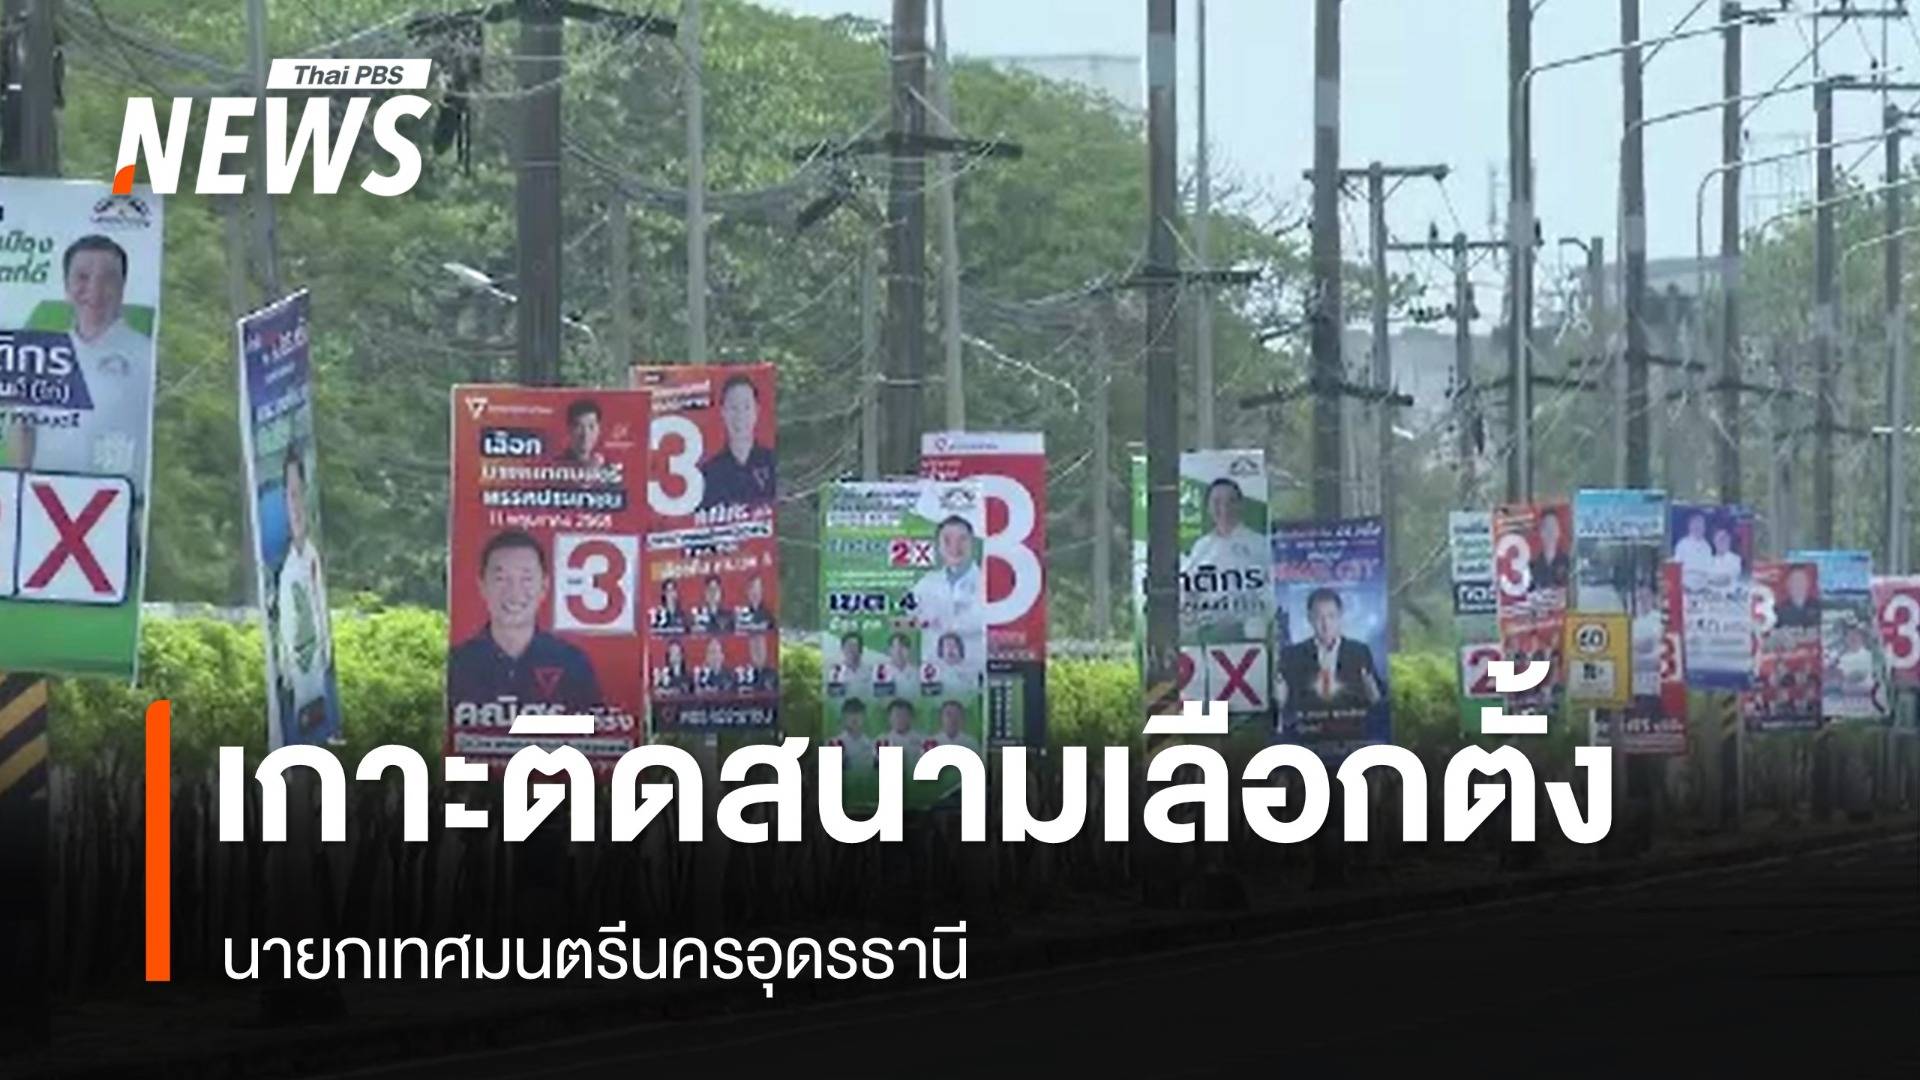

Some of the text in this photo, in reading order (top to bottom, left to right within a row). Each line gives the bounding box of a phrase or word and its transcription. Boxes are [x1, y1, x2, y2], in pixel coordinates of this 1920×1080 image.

[647, 415, 706, 517] 3
[24, 482, 118, 595] X
[1497, 533, 1531, 597] 3
[565, 540, 627, 625] 3
[1144, 565, 1263, 594] าติกร
[1884, 593, 1920, 670] 3
